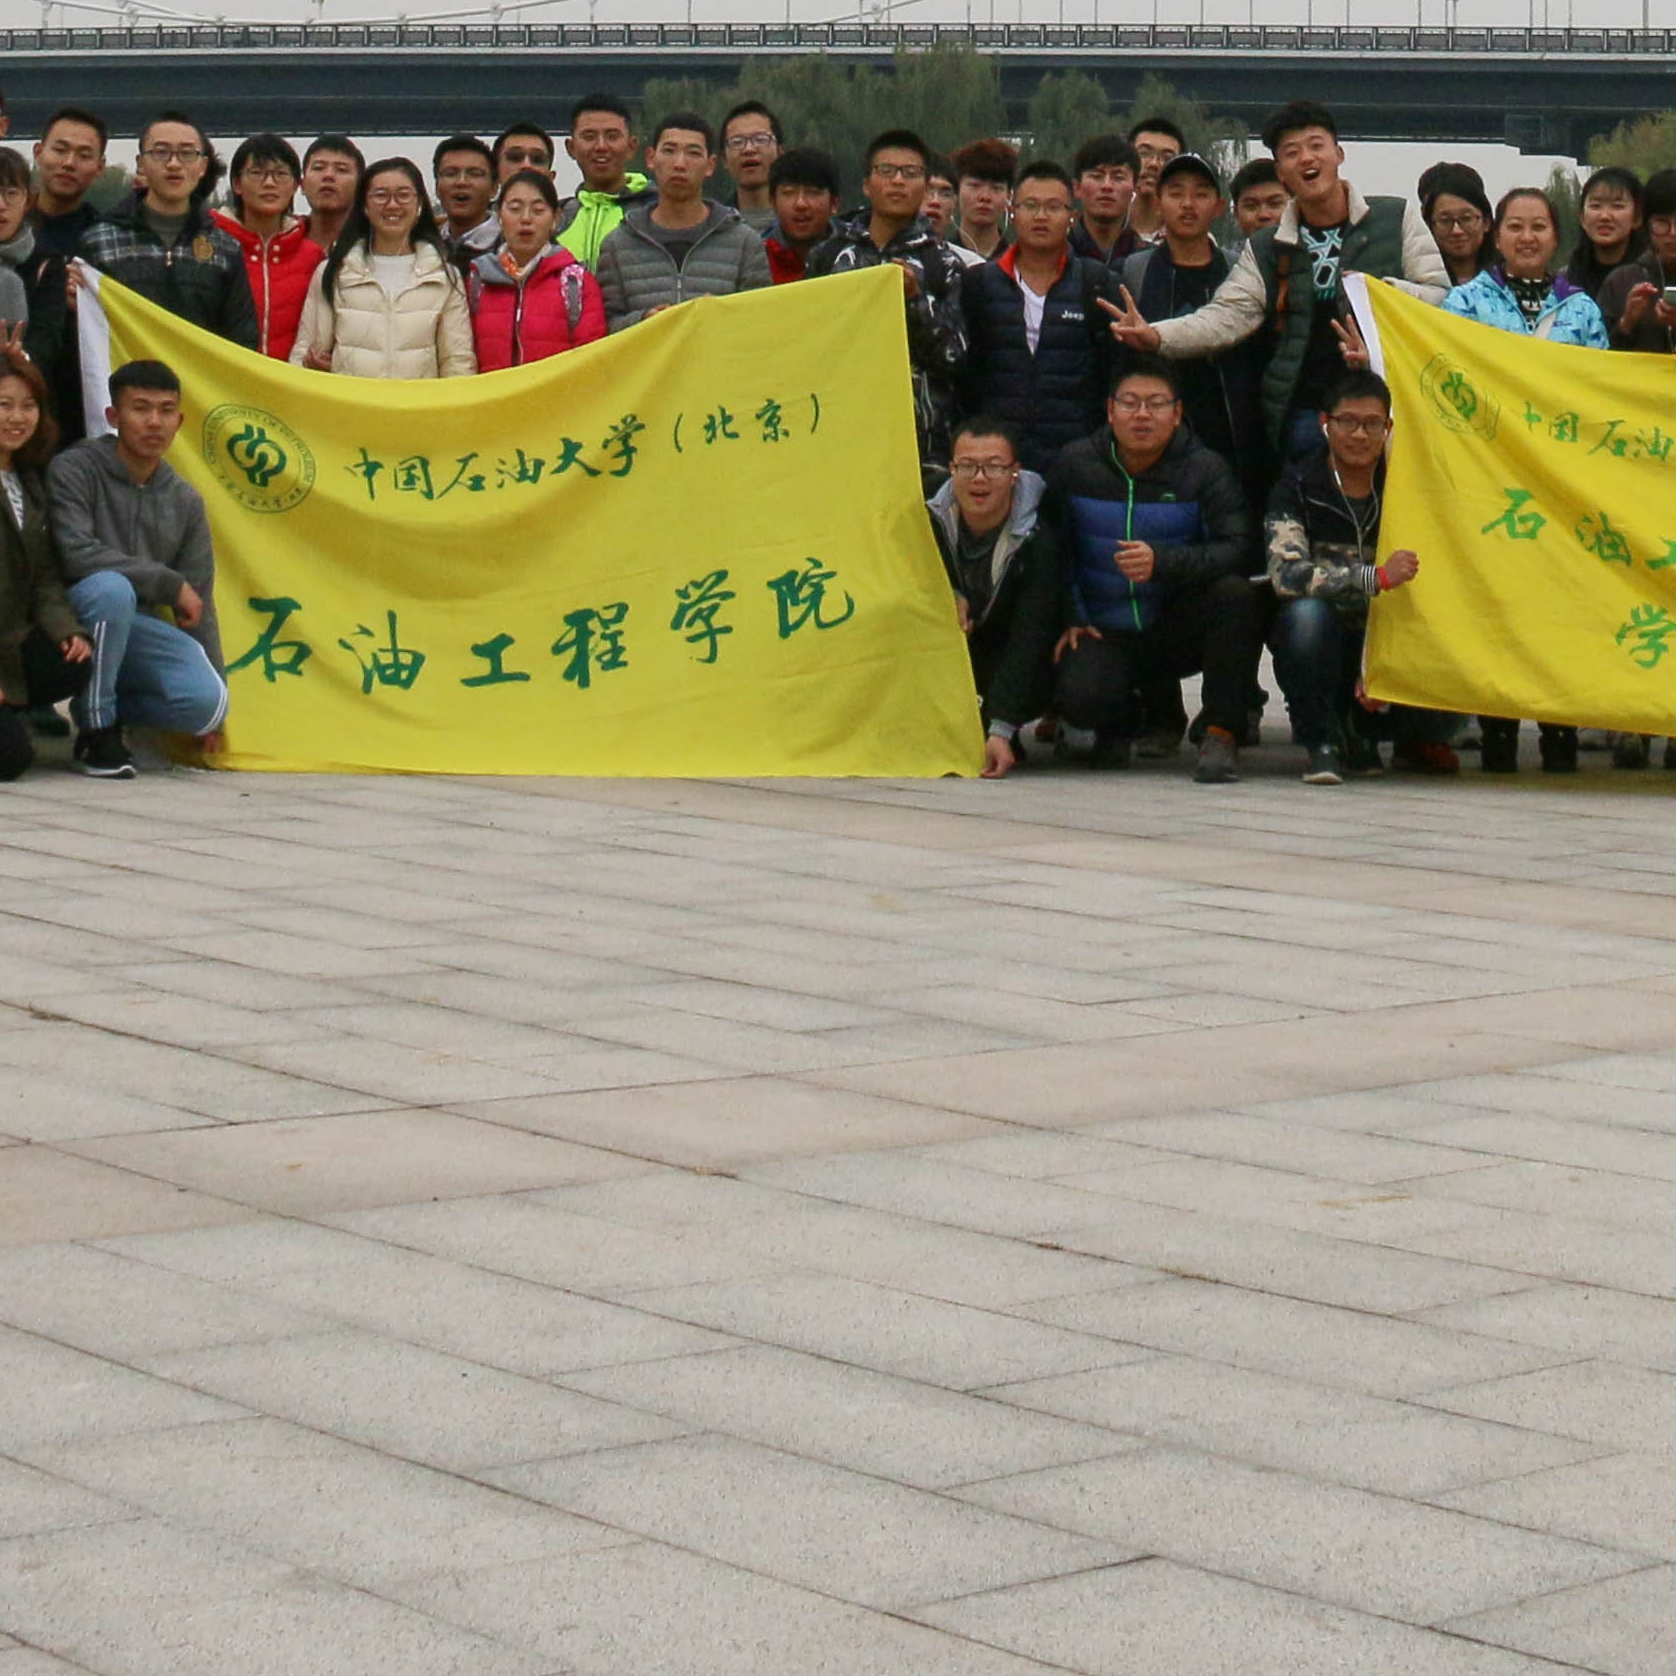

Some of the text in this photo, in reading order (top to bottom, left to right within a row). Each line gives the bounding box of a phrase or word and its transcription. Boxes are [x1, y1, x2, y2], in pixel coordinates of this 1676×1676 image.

[225, 556, 857, 694] 石油工程学院
